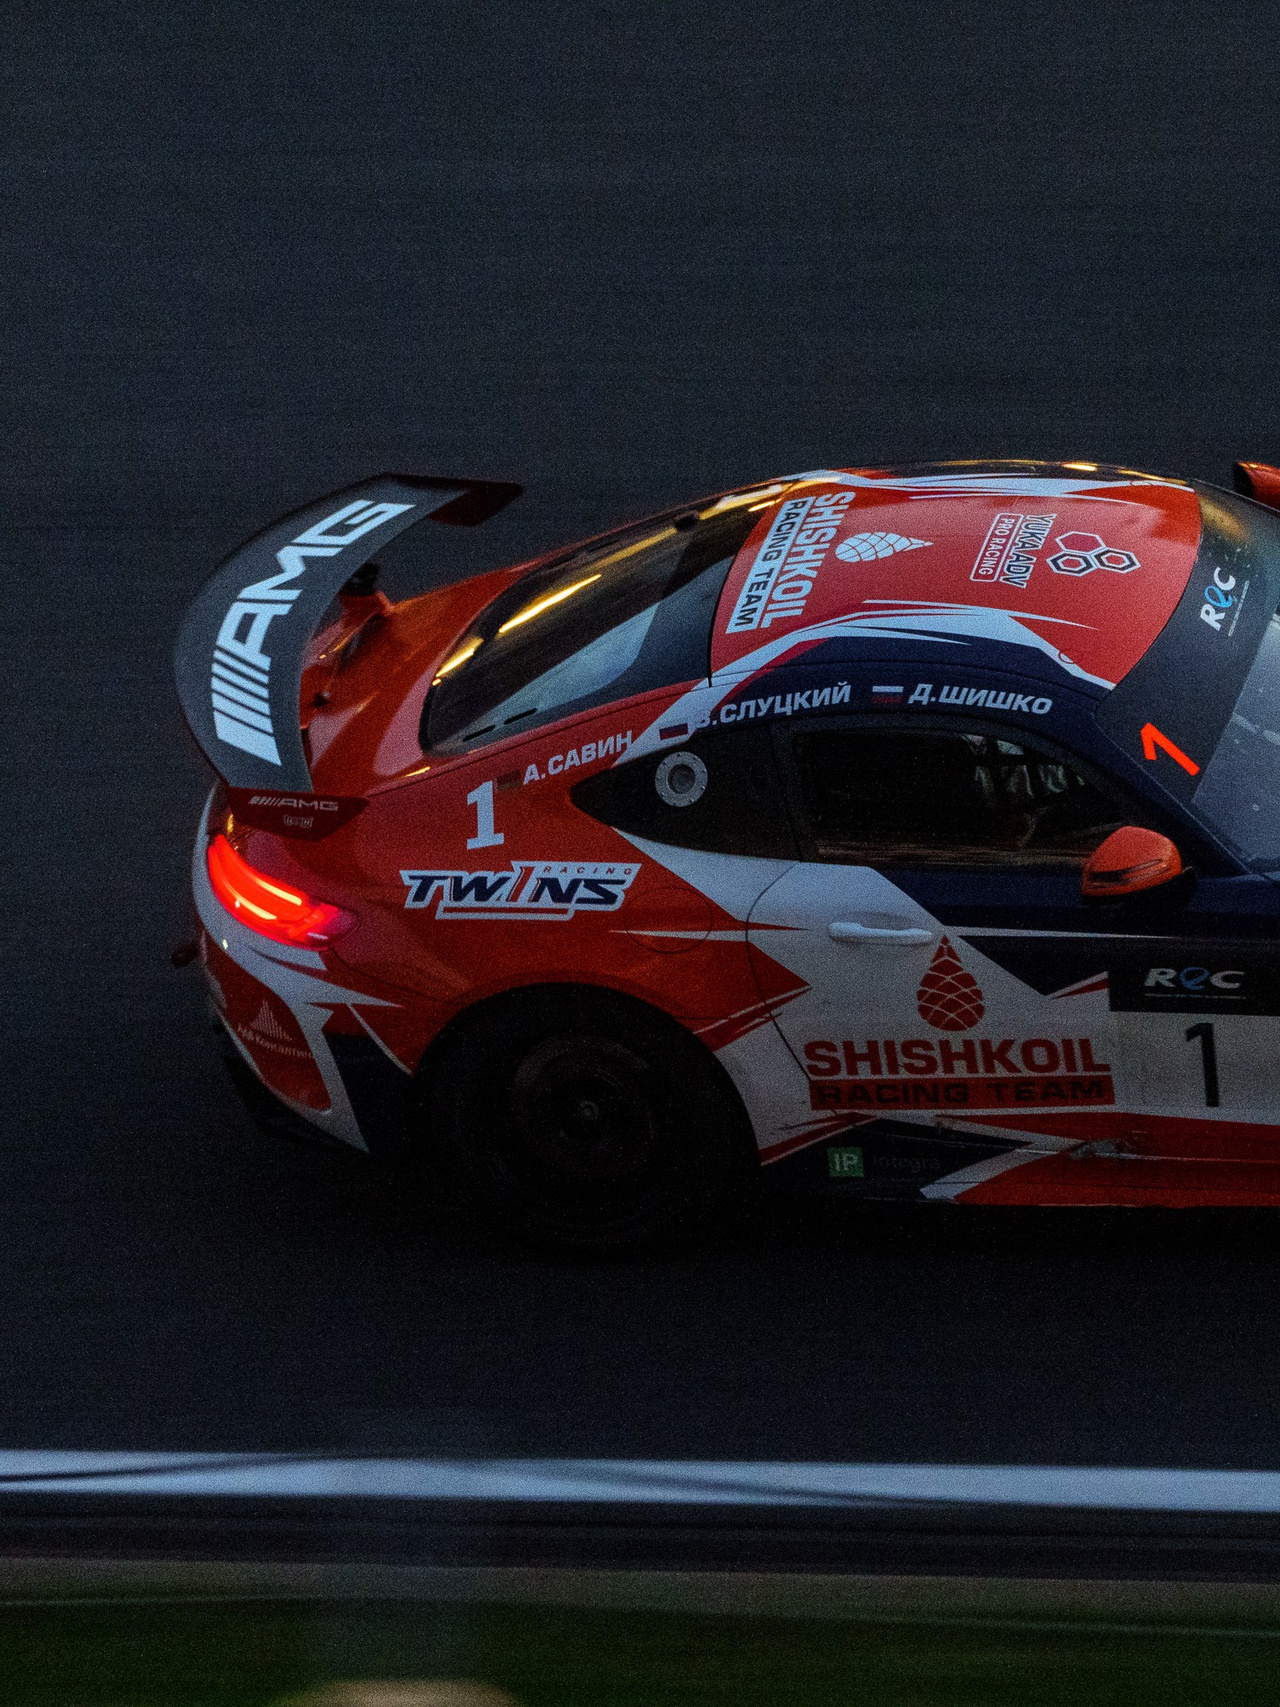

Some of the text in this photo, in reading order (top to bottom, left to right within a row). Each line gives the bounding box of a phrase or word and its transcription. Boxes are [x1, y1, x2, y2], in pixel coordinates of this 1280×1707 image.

[734, 499, 807, 627] RACING TEAM
[760, 491, 856, 628] SHISHKOIL
[978, 517, 1015, 575] PRO RACING
[999, 512, 1058, 589] YUKA ADV
[217, 500, 417, 671] AMG
[907, 683, 1053, 716] Д.ШИШКО
[522, 730, 633, 786] А.САВИН
[1140, 722, 1200, 777] 1
[278, 797, 340, 812] AMG
[465, 780, 506, 851] 1
[408, 866, 627, 906] TWINS
[542, 865, 634, 876] RACING
[803, 1038, 1112, 1077] SHISHKOIL
[1184, 1022, 1220, 1107] 1
[813, 1079, 1104, 1106] RACING TEAM
[833, 1152, 859, 1172] IP
